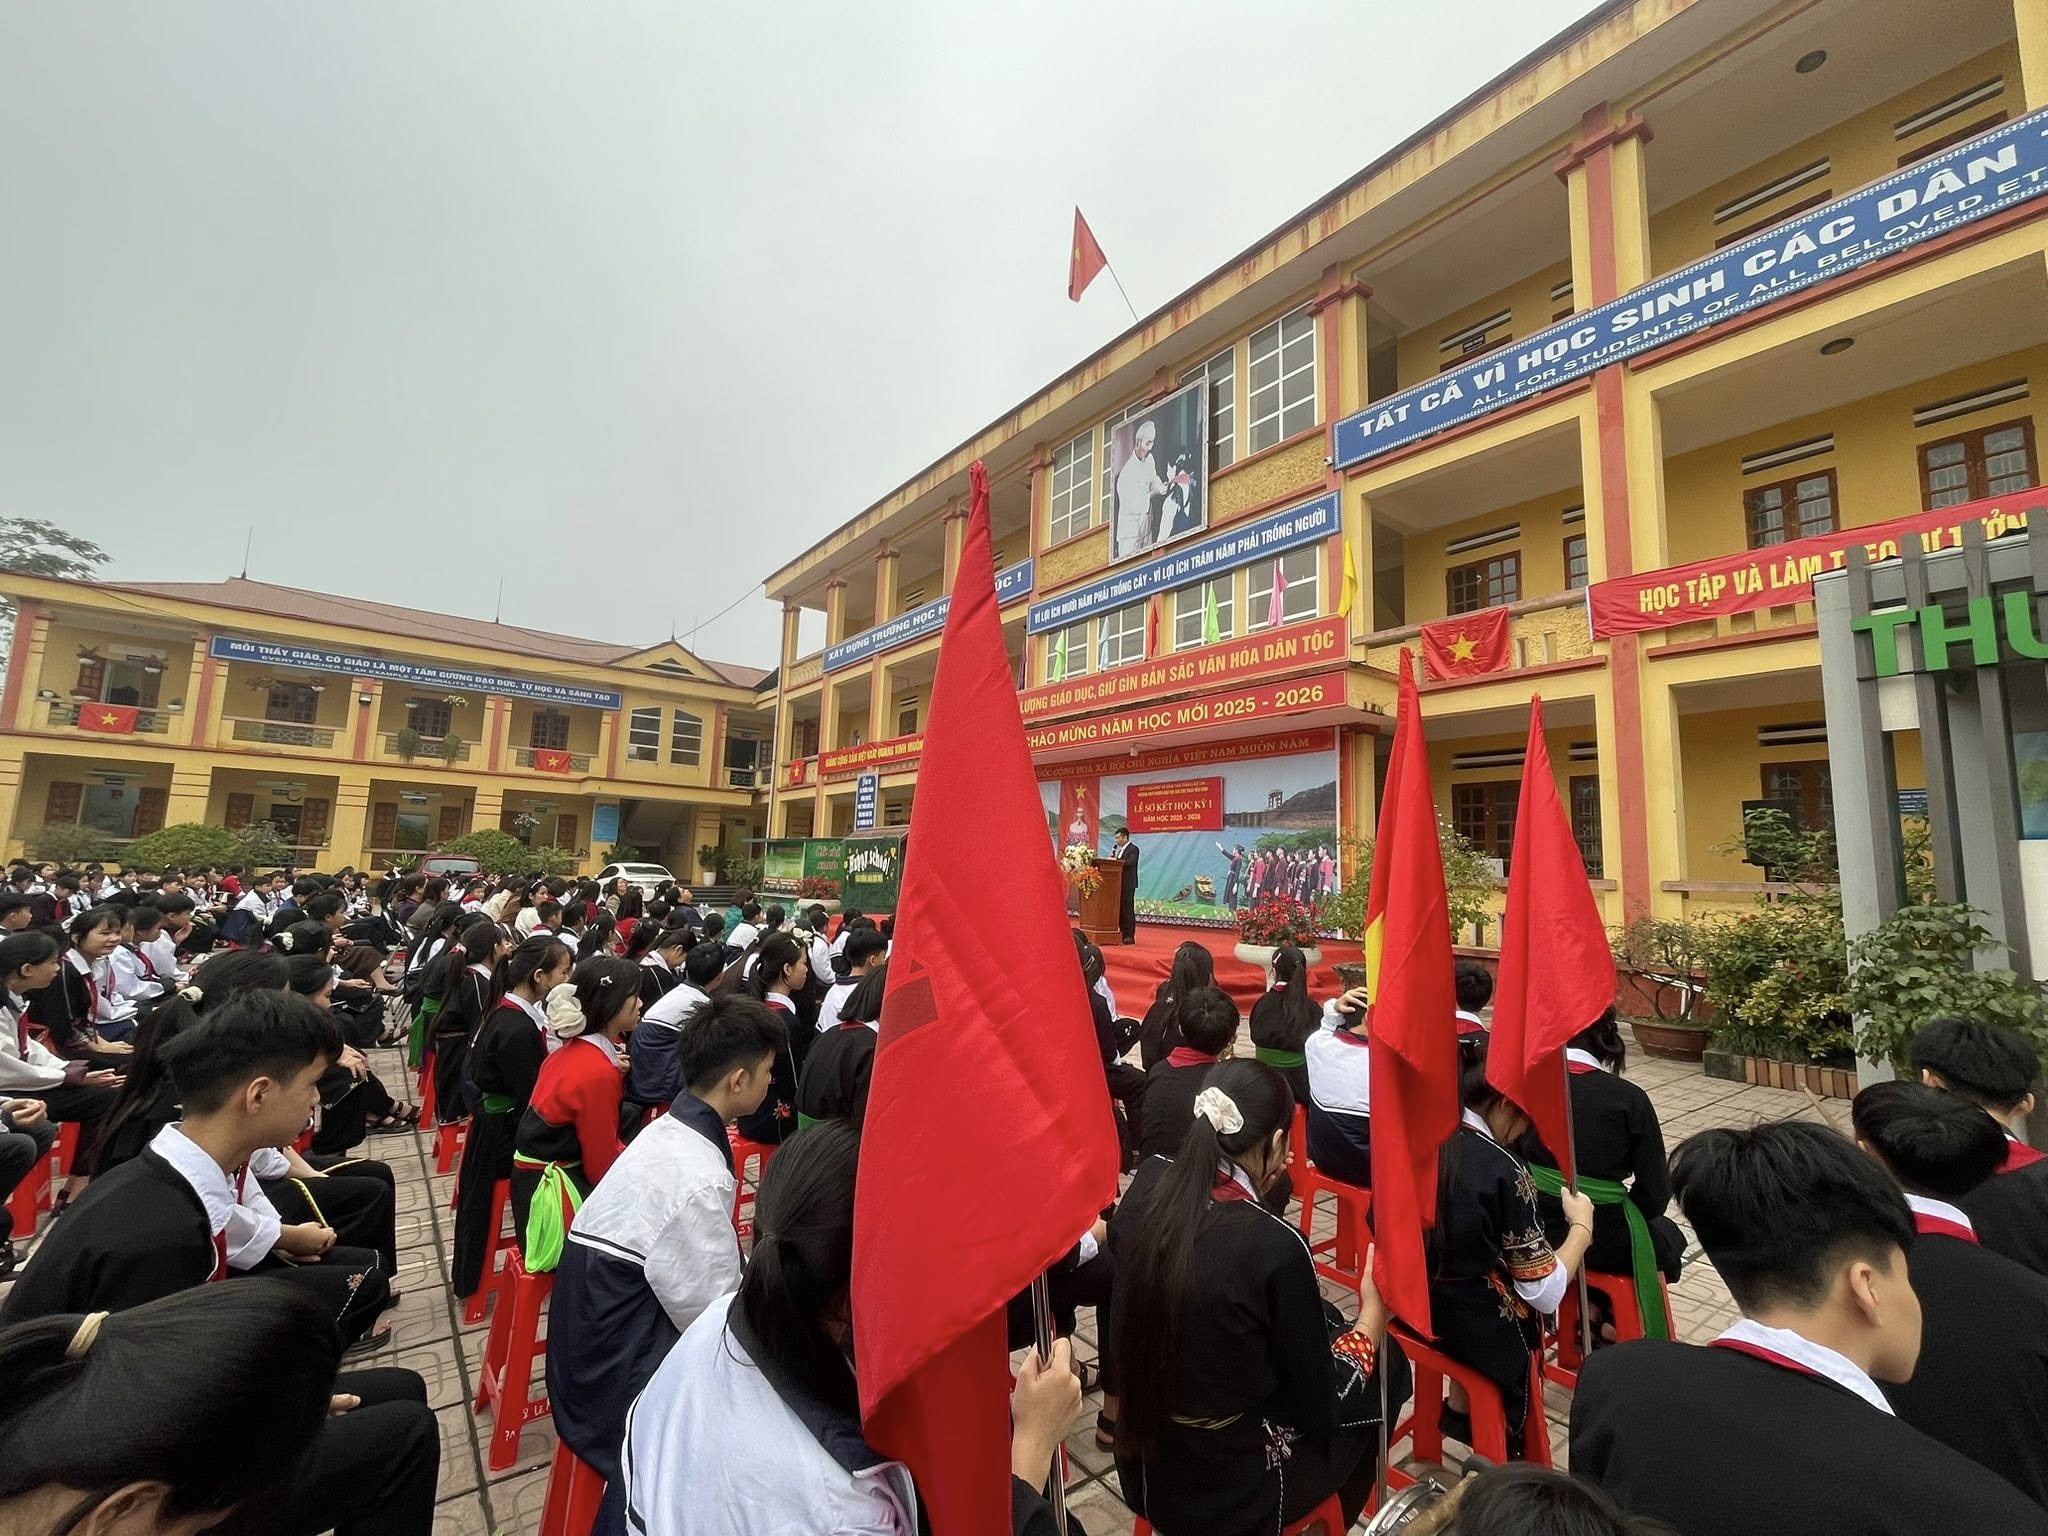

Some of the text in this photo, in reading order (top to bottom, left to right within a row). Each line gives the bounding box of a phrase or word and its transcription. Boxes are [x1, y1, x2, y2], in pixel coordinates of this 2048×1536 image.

[1359, 143, 2017, 437] TẤT CẢ VÌ HỌC SINH CÁC DÂN
[1472, 390, 1508, 408] ALL
[1515, 367, 1556, 390] FOR
[1563, 314, 1694, 371] STUDENTS
[1703, 293, 1739, 314] OF
[1749, 271, 1807, 297] ALL
[1817, 194, 1983, 269] BELOVED
[1133, 571, 1147, 589] CÂY
[1153, 566, 1161, 583] VÌ
[1162, 563, 1174, 581] LỢI
[1175, 556, 1189, 573] ÍCH
[1191, 549, 1214, 568] TRĂM
[1215, 541, 1236, 562] NĂM
[1237, 531, 1259, 554] PHẢI
[1295, 507, 1326, 533] NGƯỜI
[1639, 584, 1680, 615] HỌC
[1686, 573, 1726, 607] TẬP
[1733, 563, 1763, 595] VÀ
[1769, 555, 1823, 589] LÀM
[1829, 541, 1897, 569] TEO
[828, 647, 844, 661] XÂY
[846, 636, 870, 655] DỰNG
[871, 621, 910, 642] TRƯỜNG
[913, 608, 935, 627] HỌC
[995, 576, 1012, 592] ÚC
[1017, 571, 1022, 583] !
[261, 655, 294, 664] EVERY
[297, 660, 341, 670] TEACHER
[368, 669, 409, 679] EXAMPLE
[326, 653, 341, 663] CÔ
[344, 656, 370, 668] GIÁO
[373, 660, 386, 670] LÀ
[389, 663, 412, 674] MỘT
[521, 682, 534, 691] TỰ
[534, 684, 553, 693] HỌC
[555, 687, 567, 695] VÀ
[568, 688, 592, 699] SÁNG
[594, 692, 611, 701] TẠO
[1020, 629, 1334, 715] LƯỢNG GIÁO DỤC, GIỮ GÌN BẢN SẮC VĂN HÓA DÂN TỘC
[1058, 725, 1097, 743] MỪNG
[1101, 718, 1133, 736] NĂM
[1138, 712, 1171, 731] HỌC
[1177, 703, 1208, 724] MỚI
[1214, 697, 1256, 718] 2025
[1275, 685, 1324, 708] 2026
[1183, 748, 1207, 764] VIỆT
[1210, 745, 1236, 759] NAM
[1143, 814, 1155, 822] NĂM
[1156, 814, 1168, 823] HỌC
[1156, 800, 1172, 812] KẾT
[1174, 800, 1193, 812] HỌC
[1195, 798, 1208, 809] KỲ
